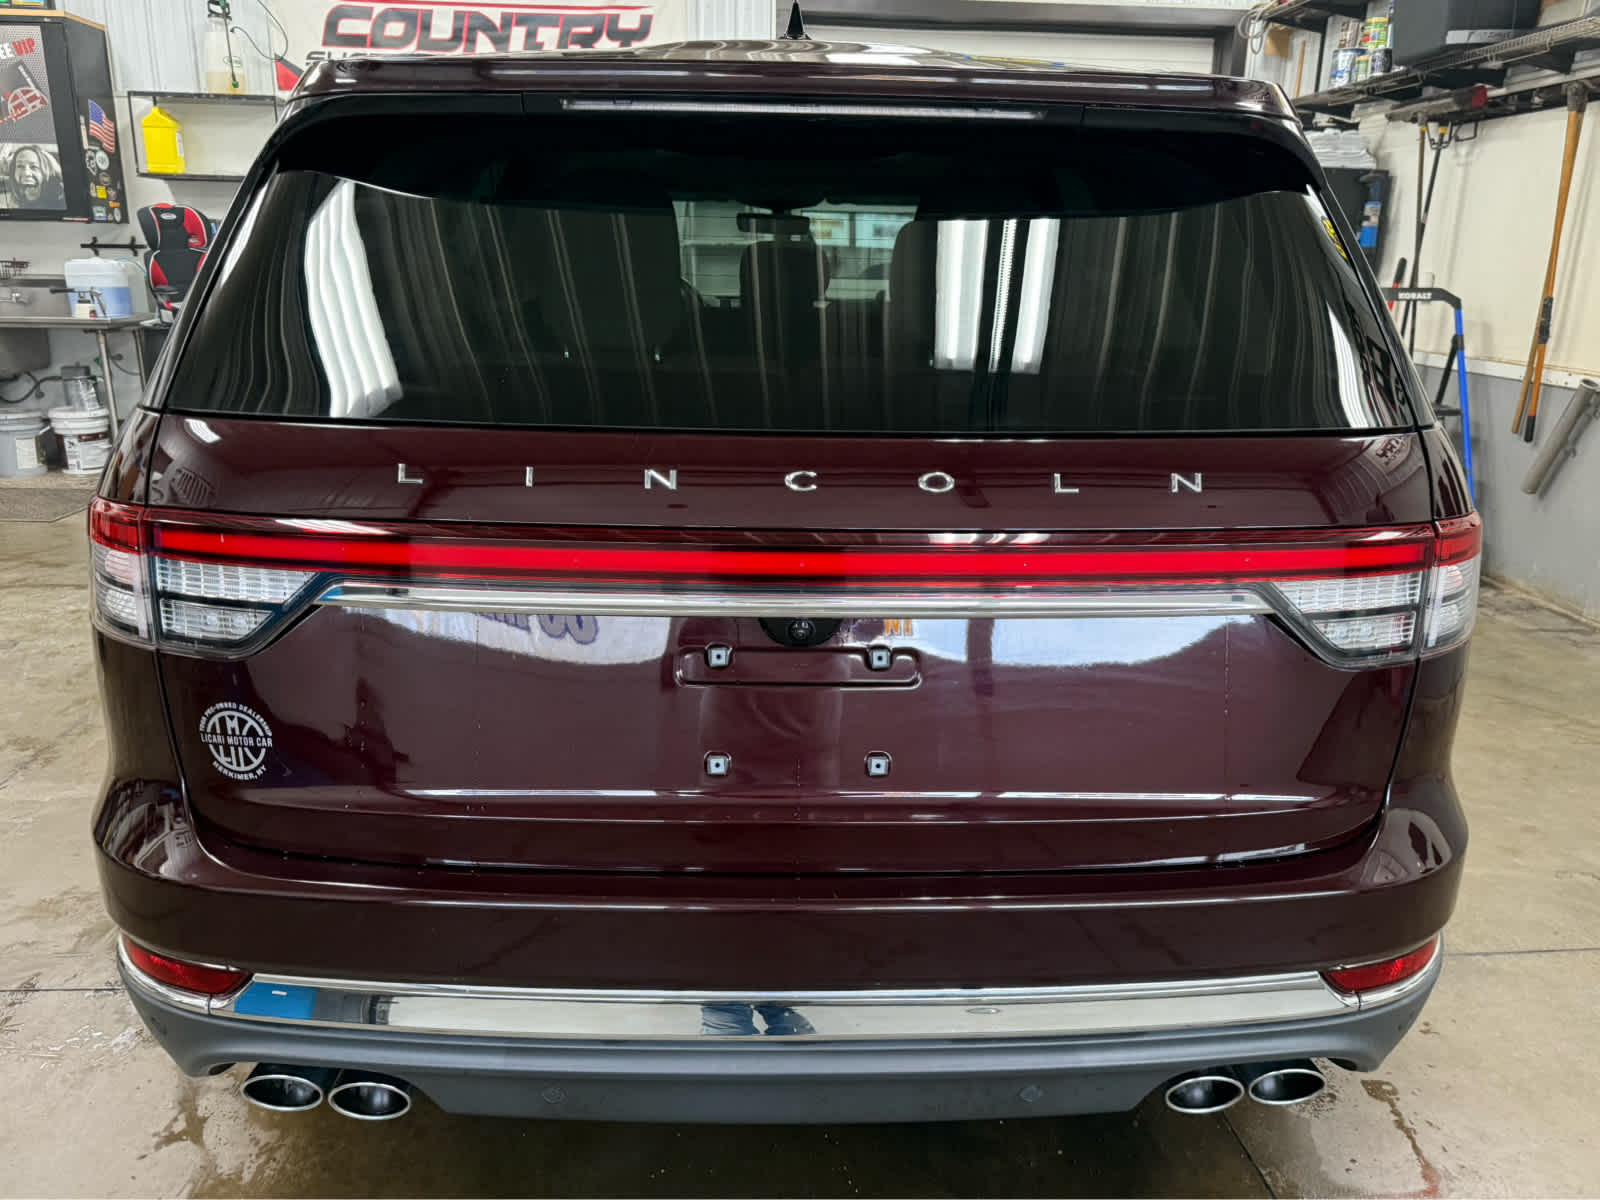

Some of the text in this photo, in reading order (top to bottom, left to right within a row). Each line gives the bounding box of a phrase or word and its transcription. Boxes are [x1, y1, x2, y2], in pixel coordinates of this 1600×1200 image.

[322, 4, 654, 54] COUNTRY
[396, 462, 1203, 494] LINCOLN
[227, 735, 254, 746] MOTOR
[256, 737, 273, 748] CAR
